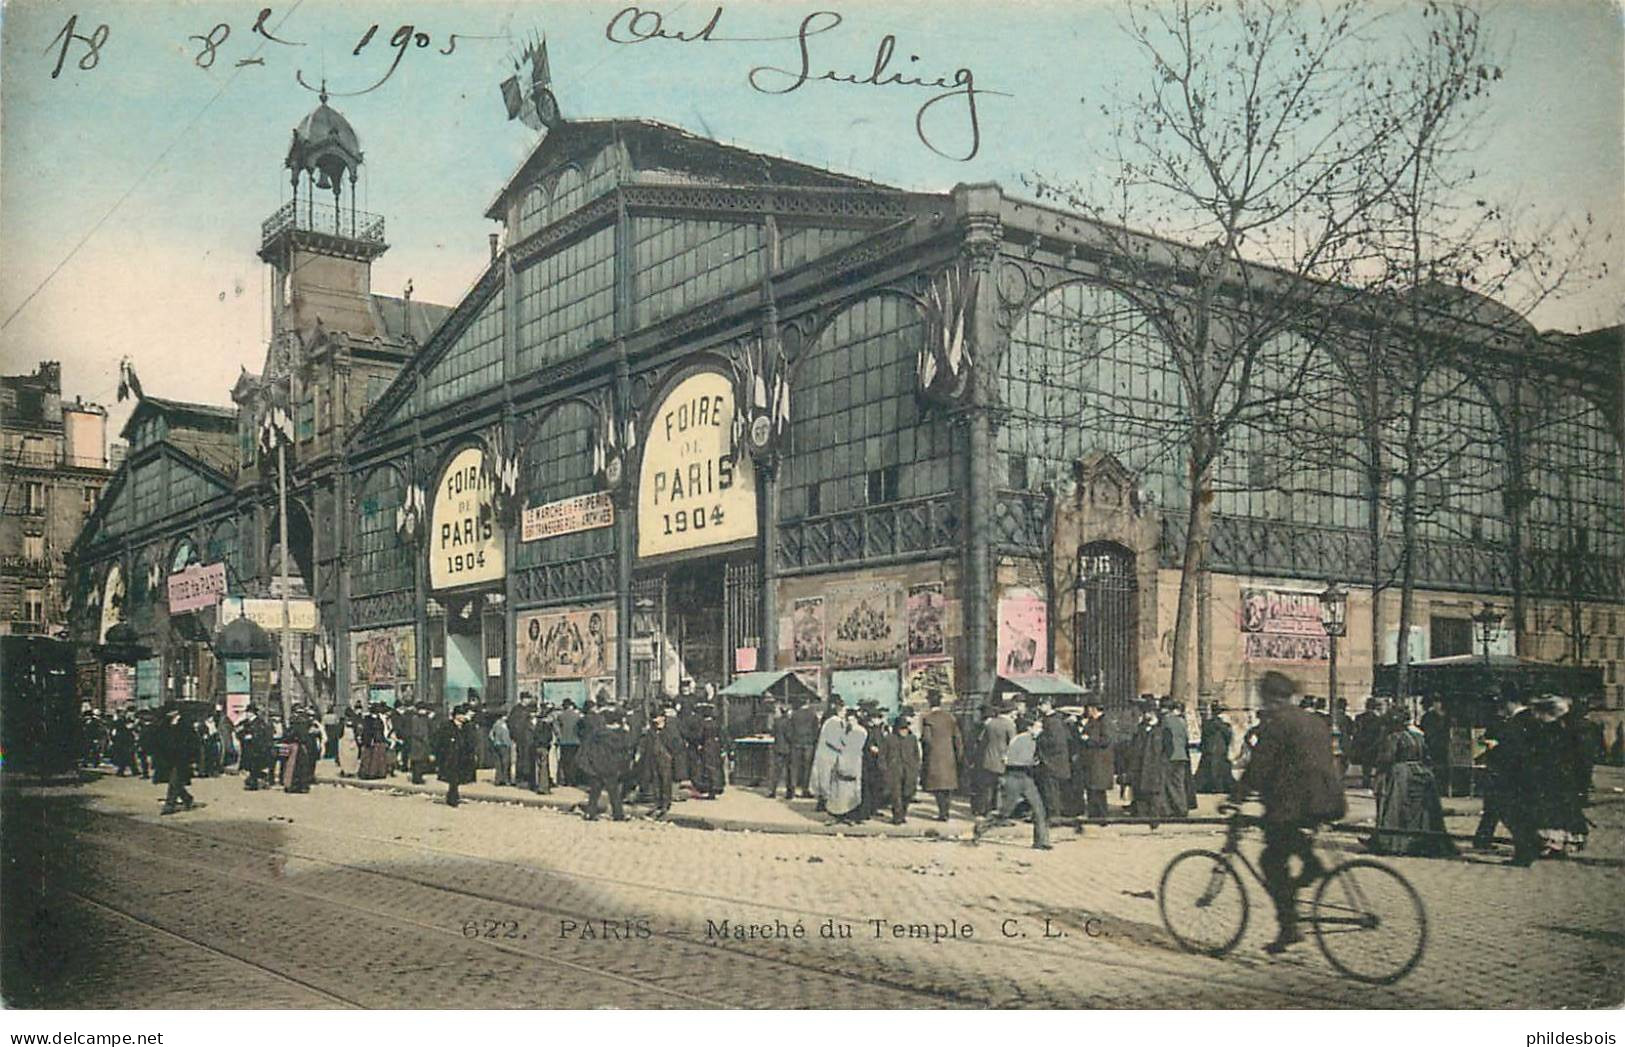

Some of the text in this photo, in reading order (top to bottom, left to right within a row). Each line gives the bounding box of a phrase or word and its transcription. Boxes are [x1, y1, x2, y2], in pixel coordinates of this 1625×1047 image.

[665, 396, 724, 441] FOIRE
[654, 454, 734, 506] PARIS
[442, 517, 493, 550] PARIS
[663, 504, 725, 535] 1904
[448, 551, 486, 574] 1904
